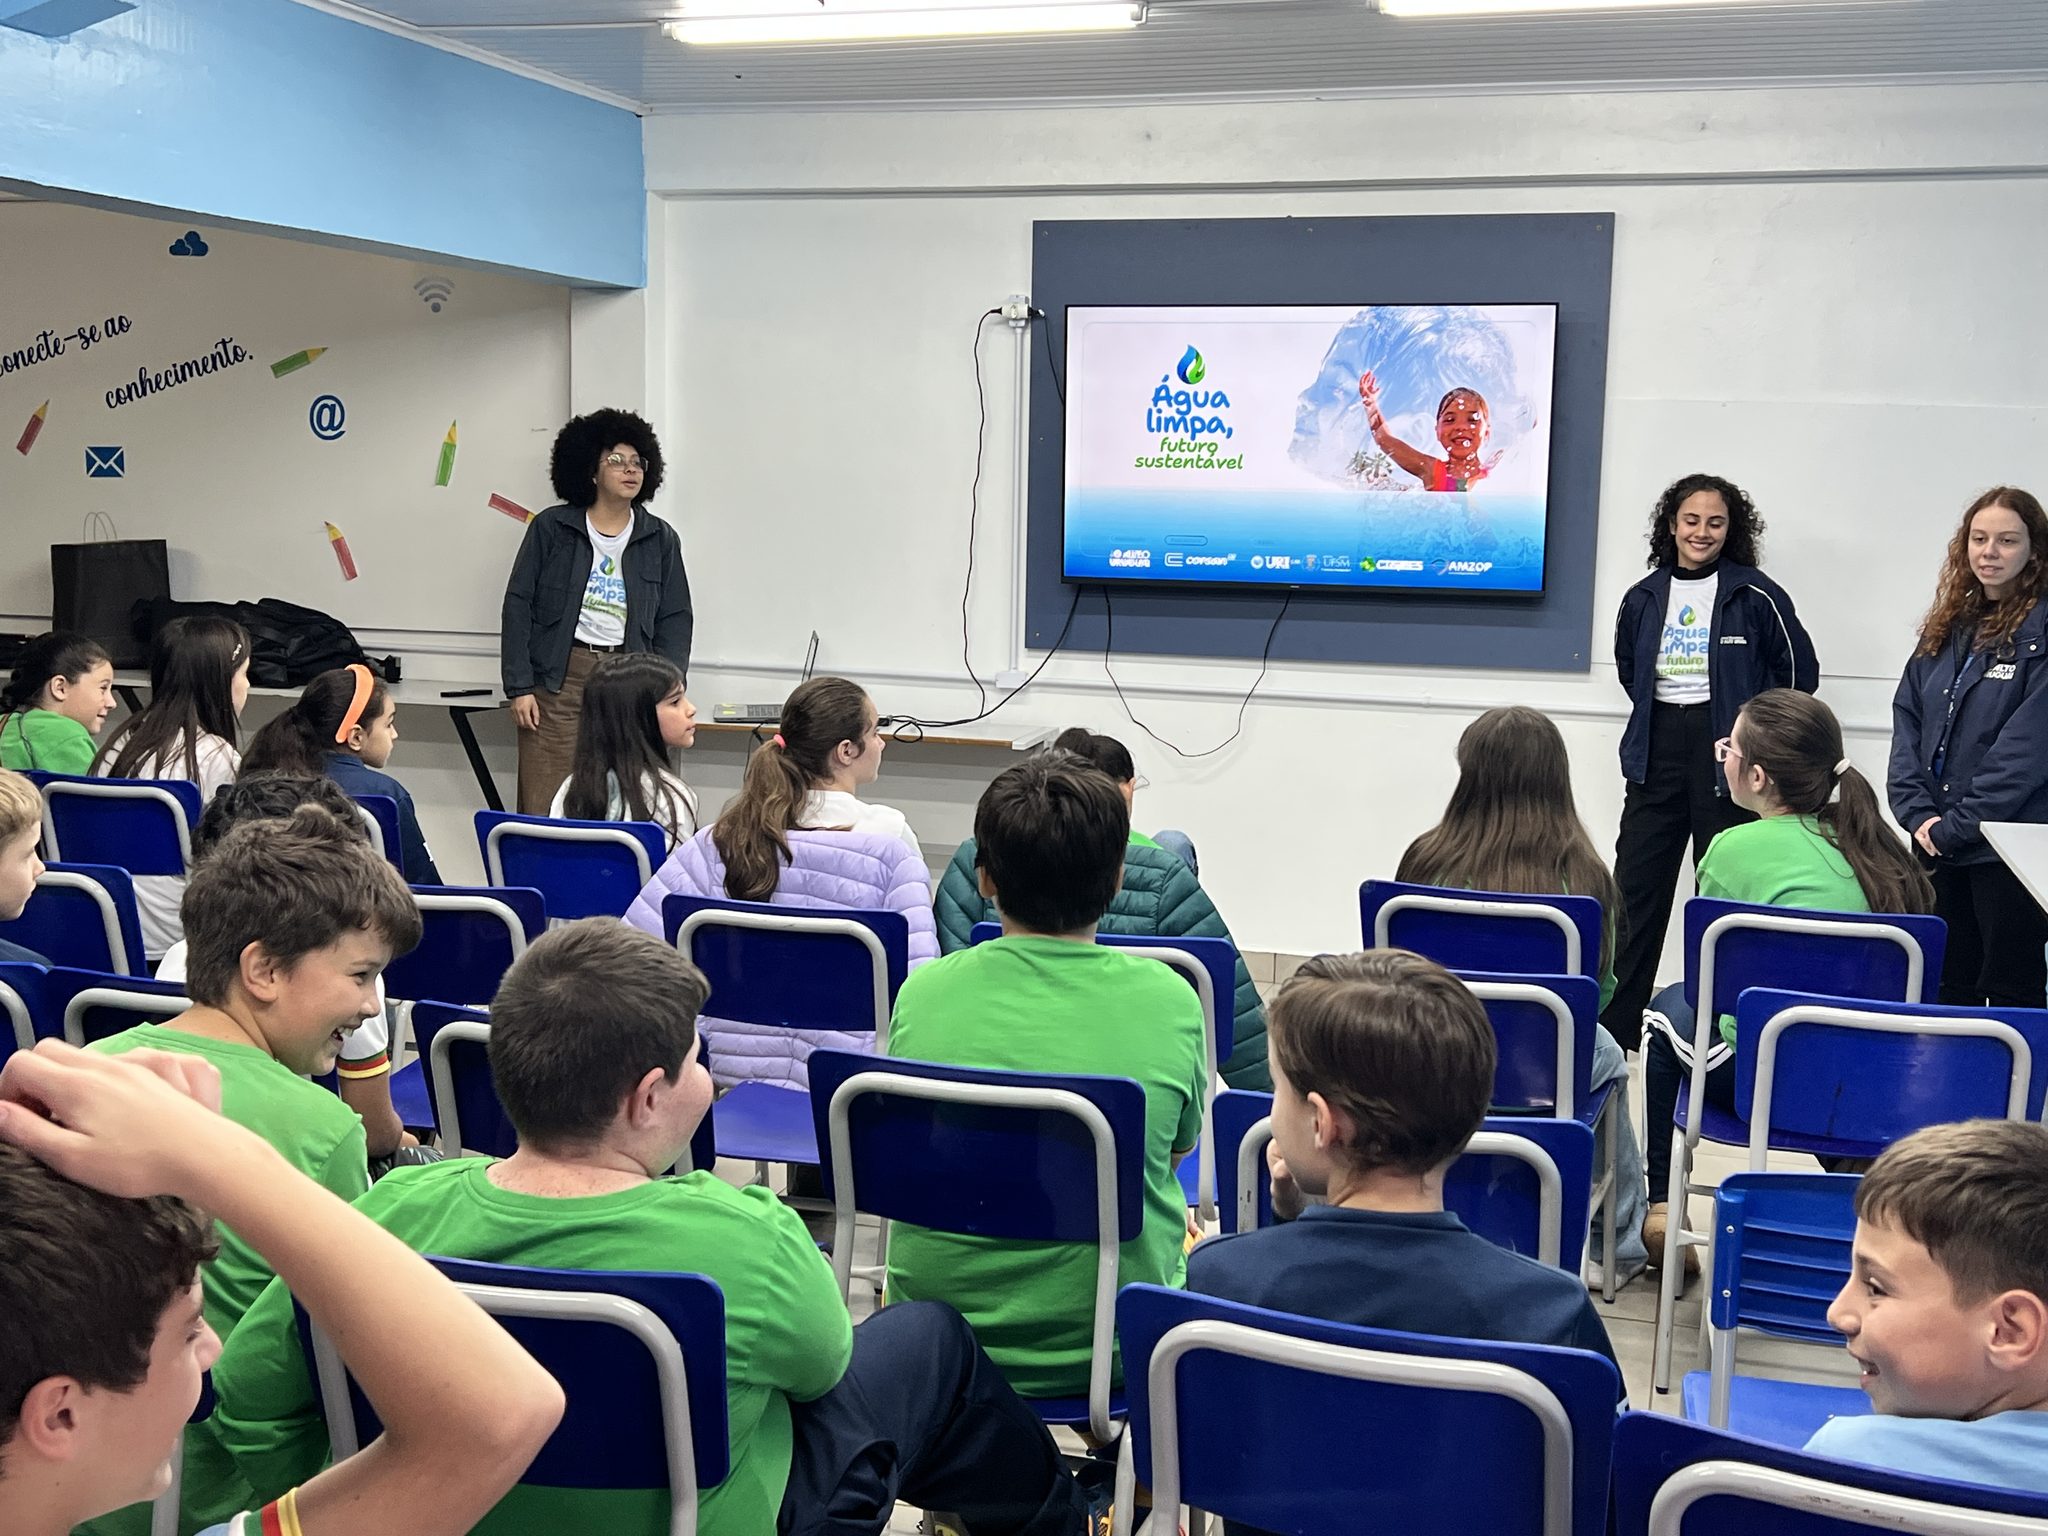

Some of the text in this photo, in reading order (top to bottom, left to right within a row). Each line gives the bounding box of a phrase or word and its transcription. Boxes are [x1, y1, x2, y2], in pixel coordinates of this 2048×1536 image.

[104, 315, 132, 338] ao
[105, 337, 254, 409] conhecimento.
[1151, 374, 1231, 416] Água
[1146, 407, 1233, 441] limpa,
[1160, 436, 1219, 453] futuro
[1134, 452, 1243, 470] sustentável
[1265, 555, 1291, 570] URI
[588, 585, 626, 603] impa
[1660, 641, 1709, 657] impa
